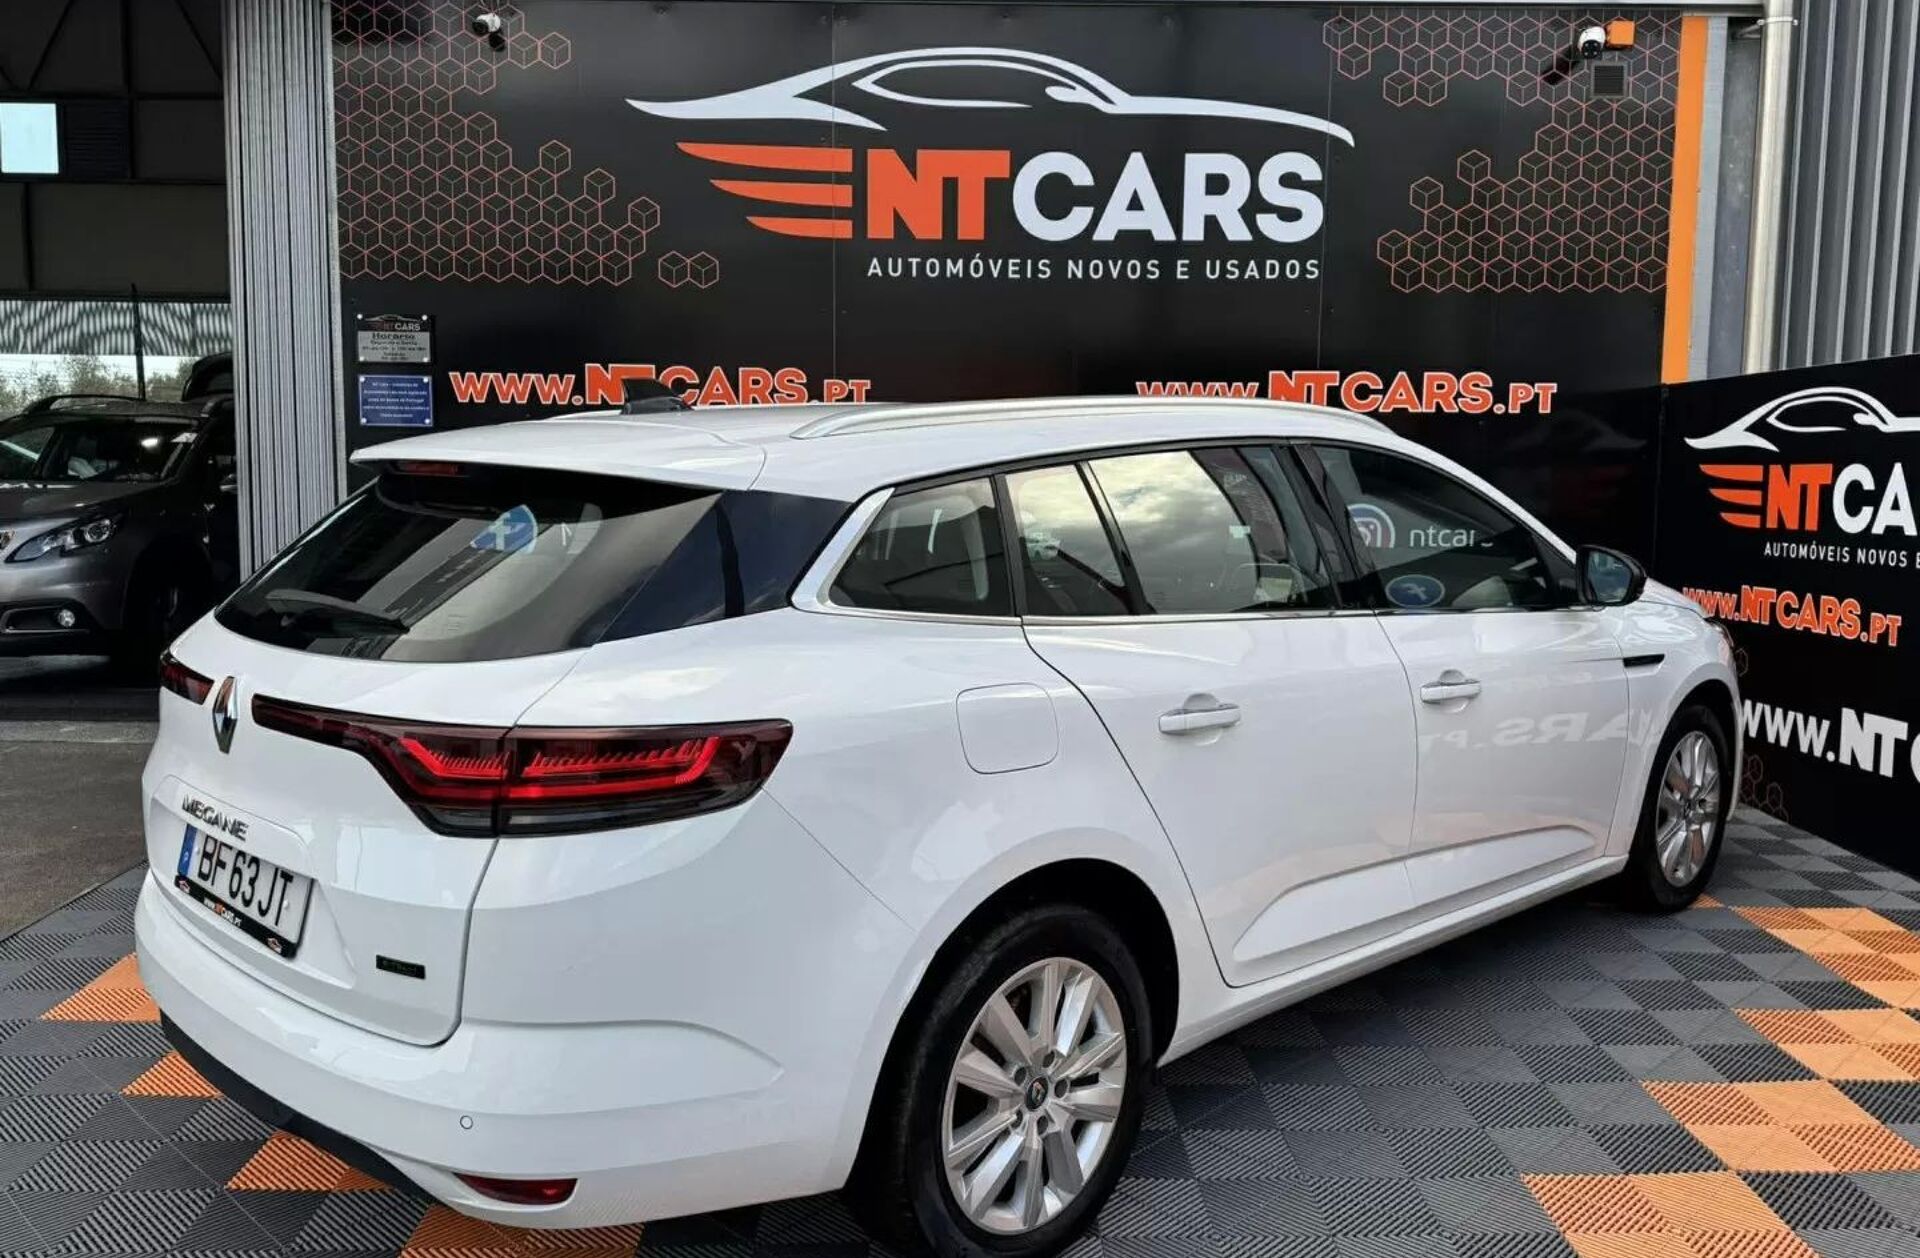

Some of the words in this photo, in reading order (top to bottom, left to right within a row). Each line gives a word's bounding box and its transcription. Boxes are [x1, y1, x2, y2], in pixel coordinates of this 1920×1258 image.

[867, 148, 1324, 242] NTCARS
[867, 253, 1052, 279] AUTOMÓVEIS
[1067, 259, 1161, 280] NOVOS
[1176, 259, 1190, 280] E
[1206, 259, 1321, 280] USADOS
[1764, 540, 1851, 563] AUTOMÓVEIS
[1856, 548, 1908, 568] NOVOS
[181, 793, 249, 842] MEGANE
[198, 833, 233, 887] BF
[229, 850, 260, 908] 63
[258, 866, 294, 927] JT
